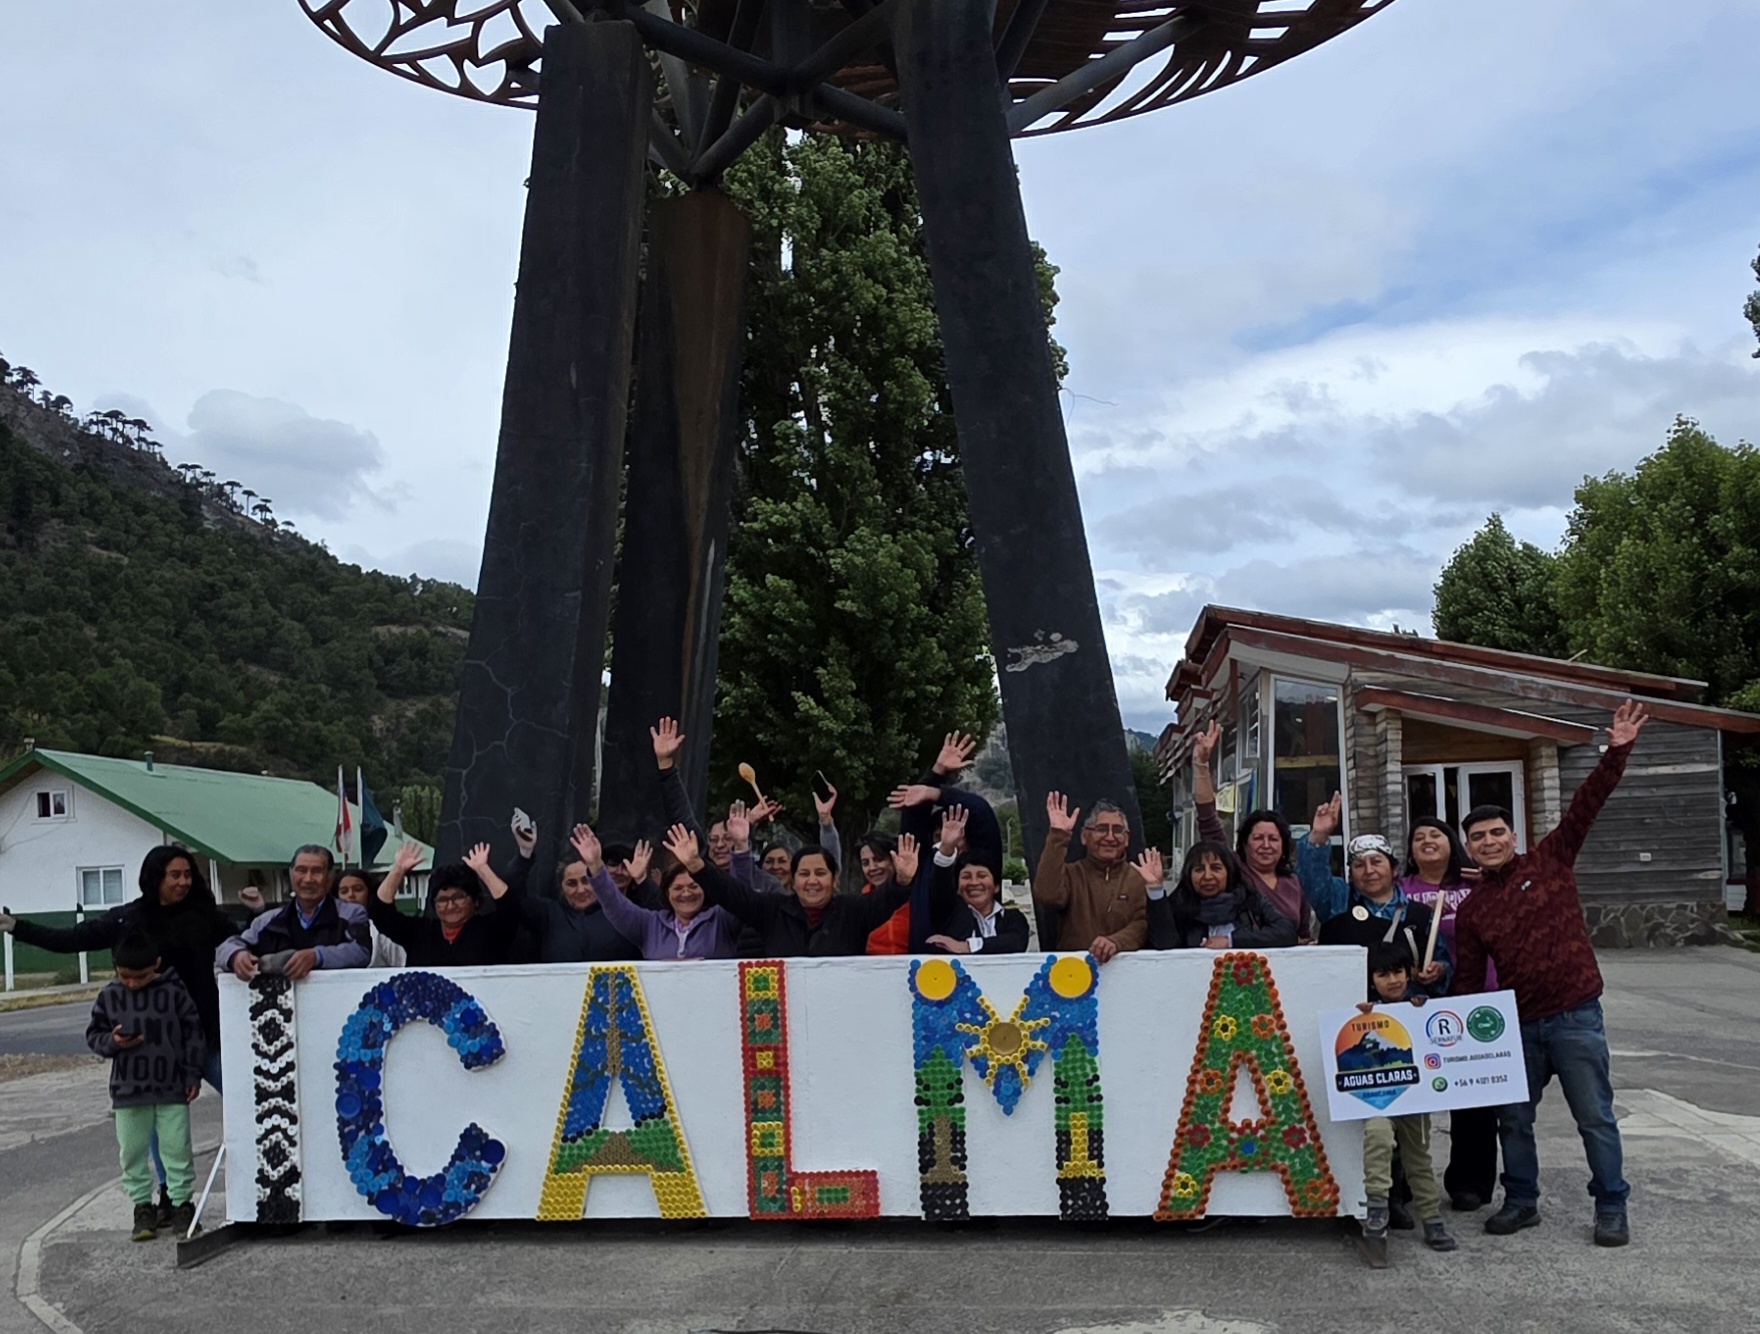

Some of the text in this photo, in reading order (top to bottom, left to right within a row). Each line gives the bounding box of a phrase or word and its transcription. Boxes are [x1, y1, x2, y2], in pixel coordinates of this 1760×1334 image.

[1351, 1020, 1390, 1032] TURISMO
[1438, 1018, 1451, 1035] R
[1343, 1069, 1413, 1088] AGUAS CLARAS
[1454, 1078, 1468, 1087] +56
[1469, 1078, 1474, 1086] 9
[248, 951, 1341, 1227] ICALMA
